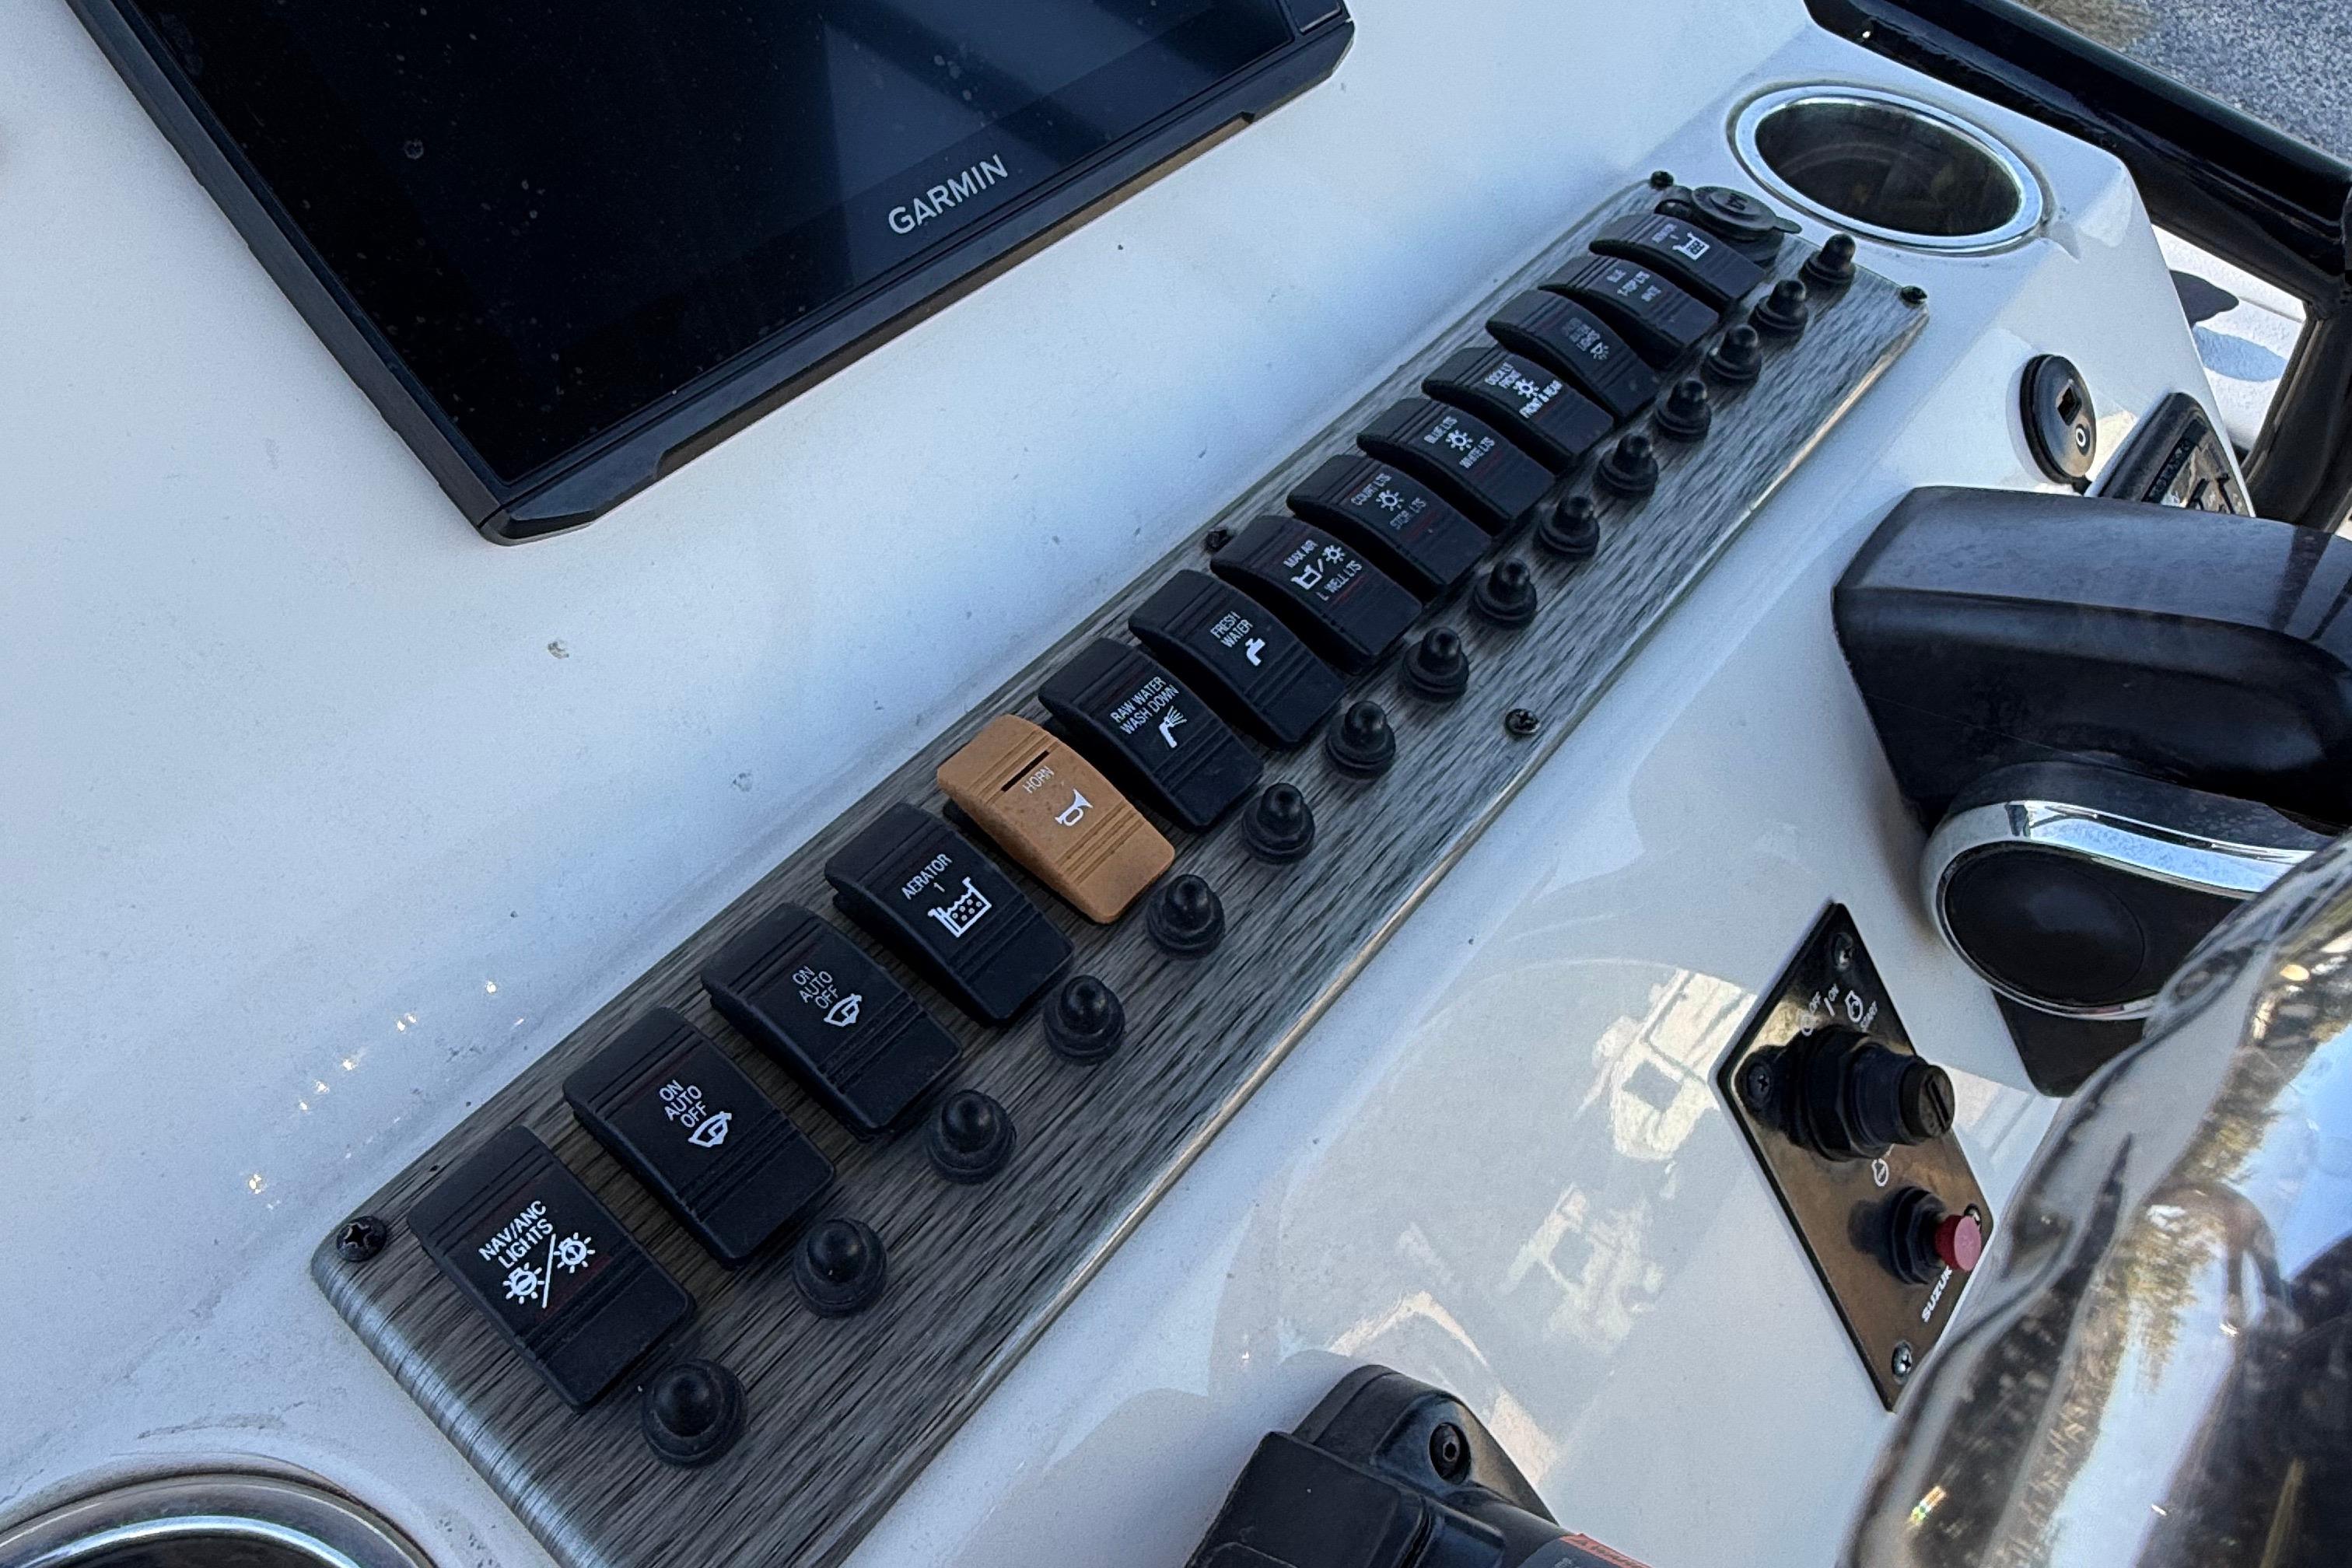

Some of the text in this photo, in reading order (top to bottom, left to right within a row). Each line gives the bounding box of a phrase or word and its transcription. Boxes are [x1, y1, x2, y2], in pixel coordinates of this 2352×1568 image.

[888, 153, 1008, 234] GARMIN
[1324, 570, 1349, 593] WELL
[1344, 560, 1363, 577] LTS
[1209, 611, 1241, 639] FRESH
[1220, 618, 1253, 648] WATER
[1110, 676, 1166, 724] RAW WATER
[1119, 684, 1179, 735] WASH DOWN
[1021, 765, 1055, 794] HORN
[901, 852, 953, 900] AERATOR
[933, 881, 946, 893] 1
[792, 965, 815, 986] ON
[799, 971, 833, 1003] AUTO
[814, 985, 839, 1010] OFF
[1828, 983, 1839, 1002] ON
[659, 1080, 684, 1102] ON
[663, 1085, 702, 1121] AUTO
[680, 1102, 708, 1128] OFF
[478, 1199, 546, 1262] NAV/ANC
[498, 1218, 555, 1269] LIGHTS
[1921, 1265, 1952, 1322] SUZUK
